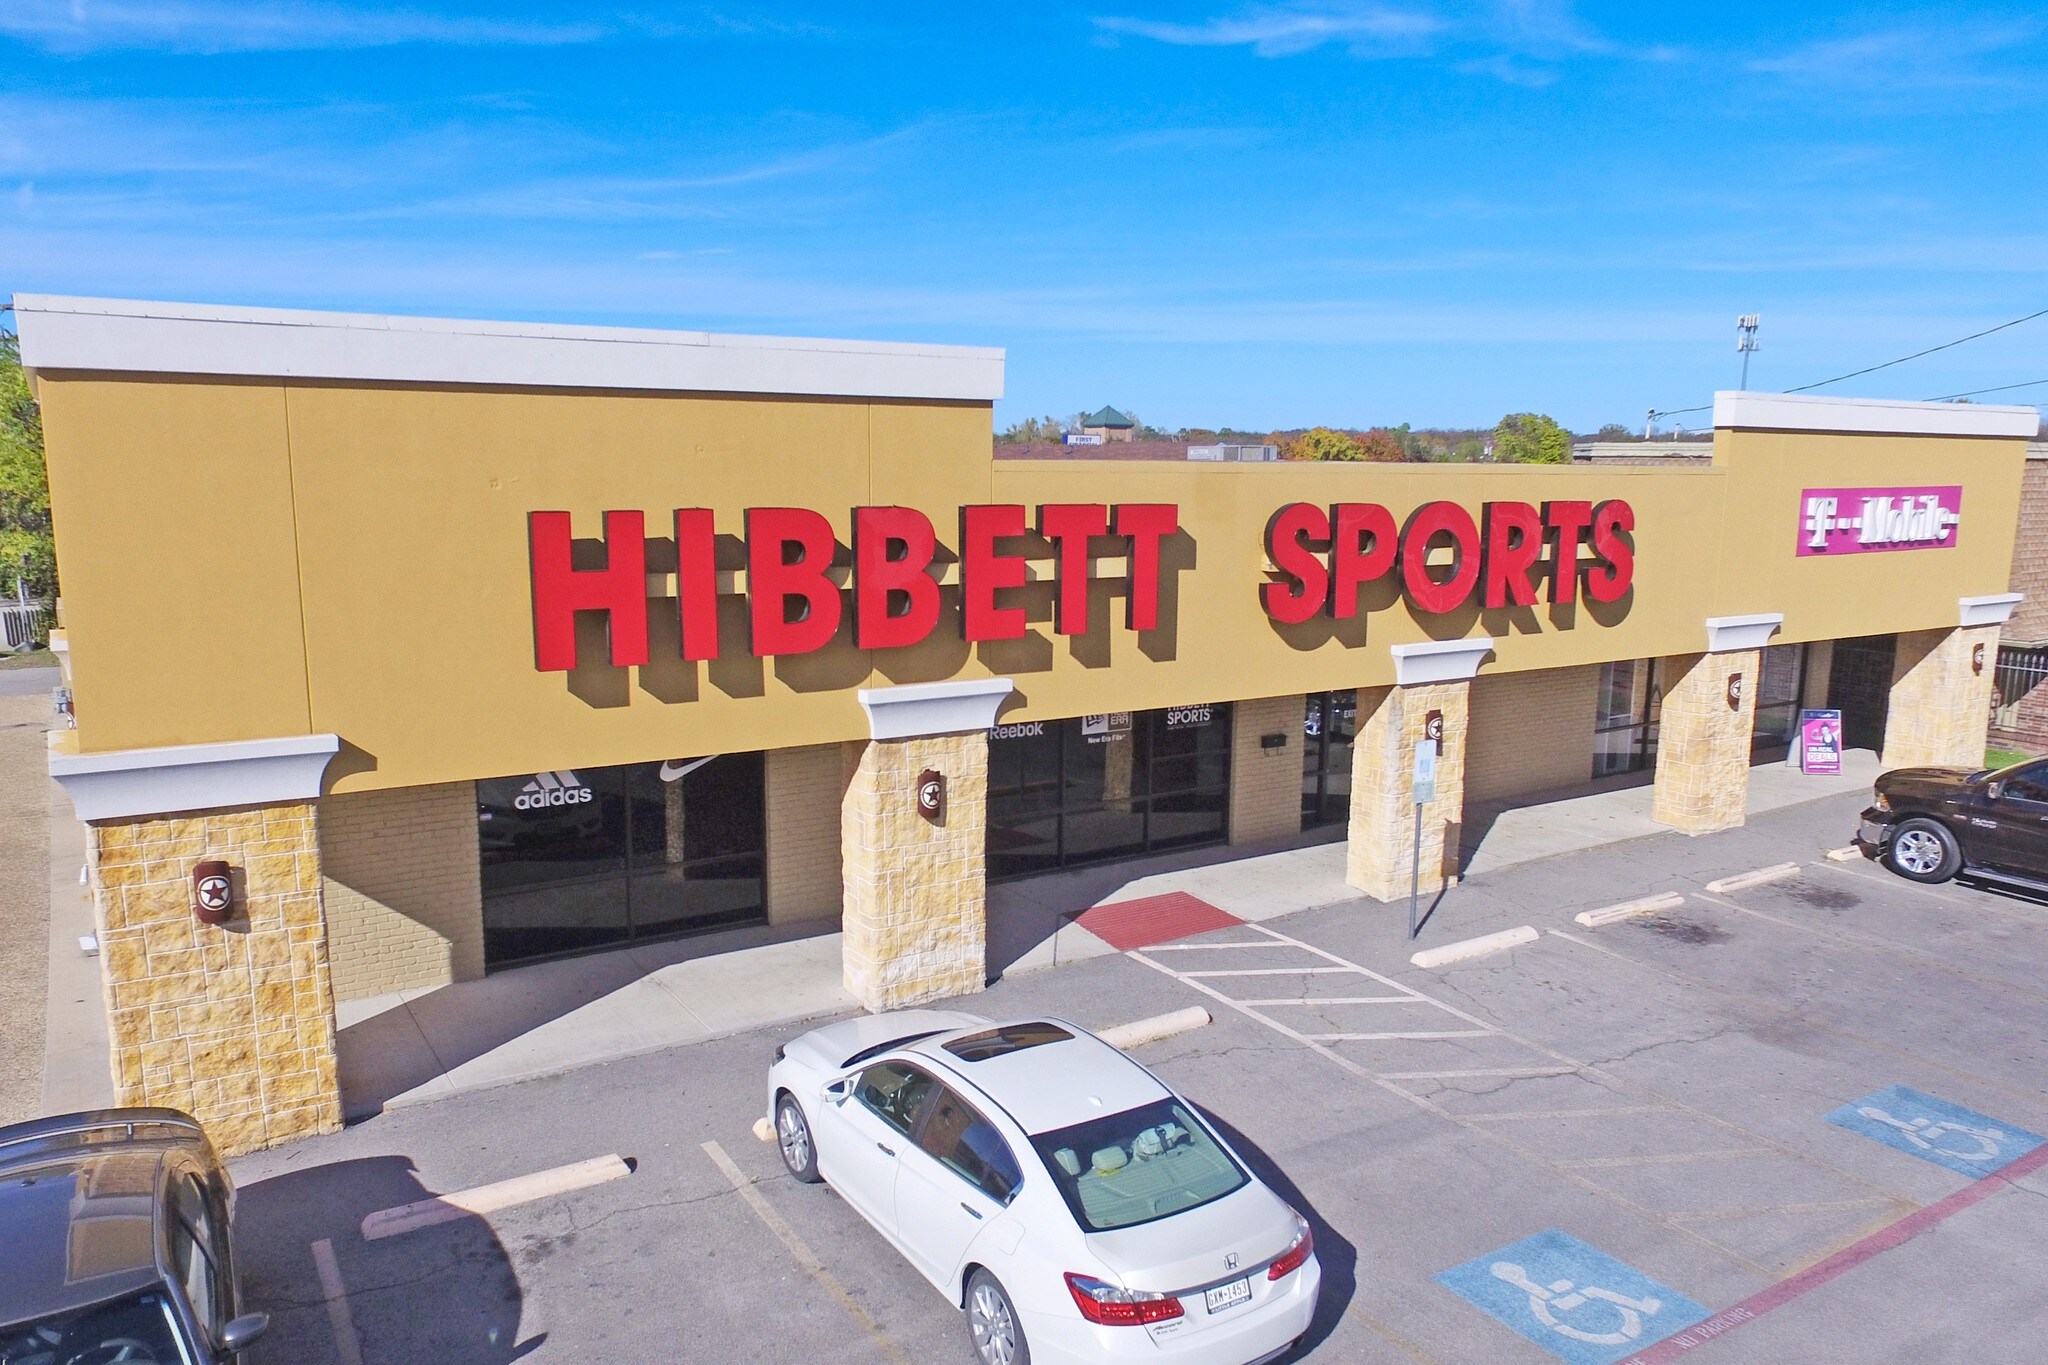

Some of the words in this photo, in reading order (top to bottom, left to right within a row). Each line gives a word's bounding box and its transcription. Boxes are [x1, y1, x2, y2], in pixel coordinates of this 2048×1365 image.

[528, 503, 1178, 671] HIBBETT
[1259, 500, 1635, 624] SPORTS
[989, 722, 1044, 739] Reebok
[1809, 753, 1836, 761] DEALS
[514, 787, 593, 810] adidas
[1670, 1334, 1699, 1350] NO
[1695, 1307, 1754, 1339] PARKING
